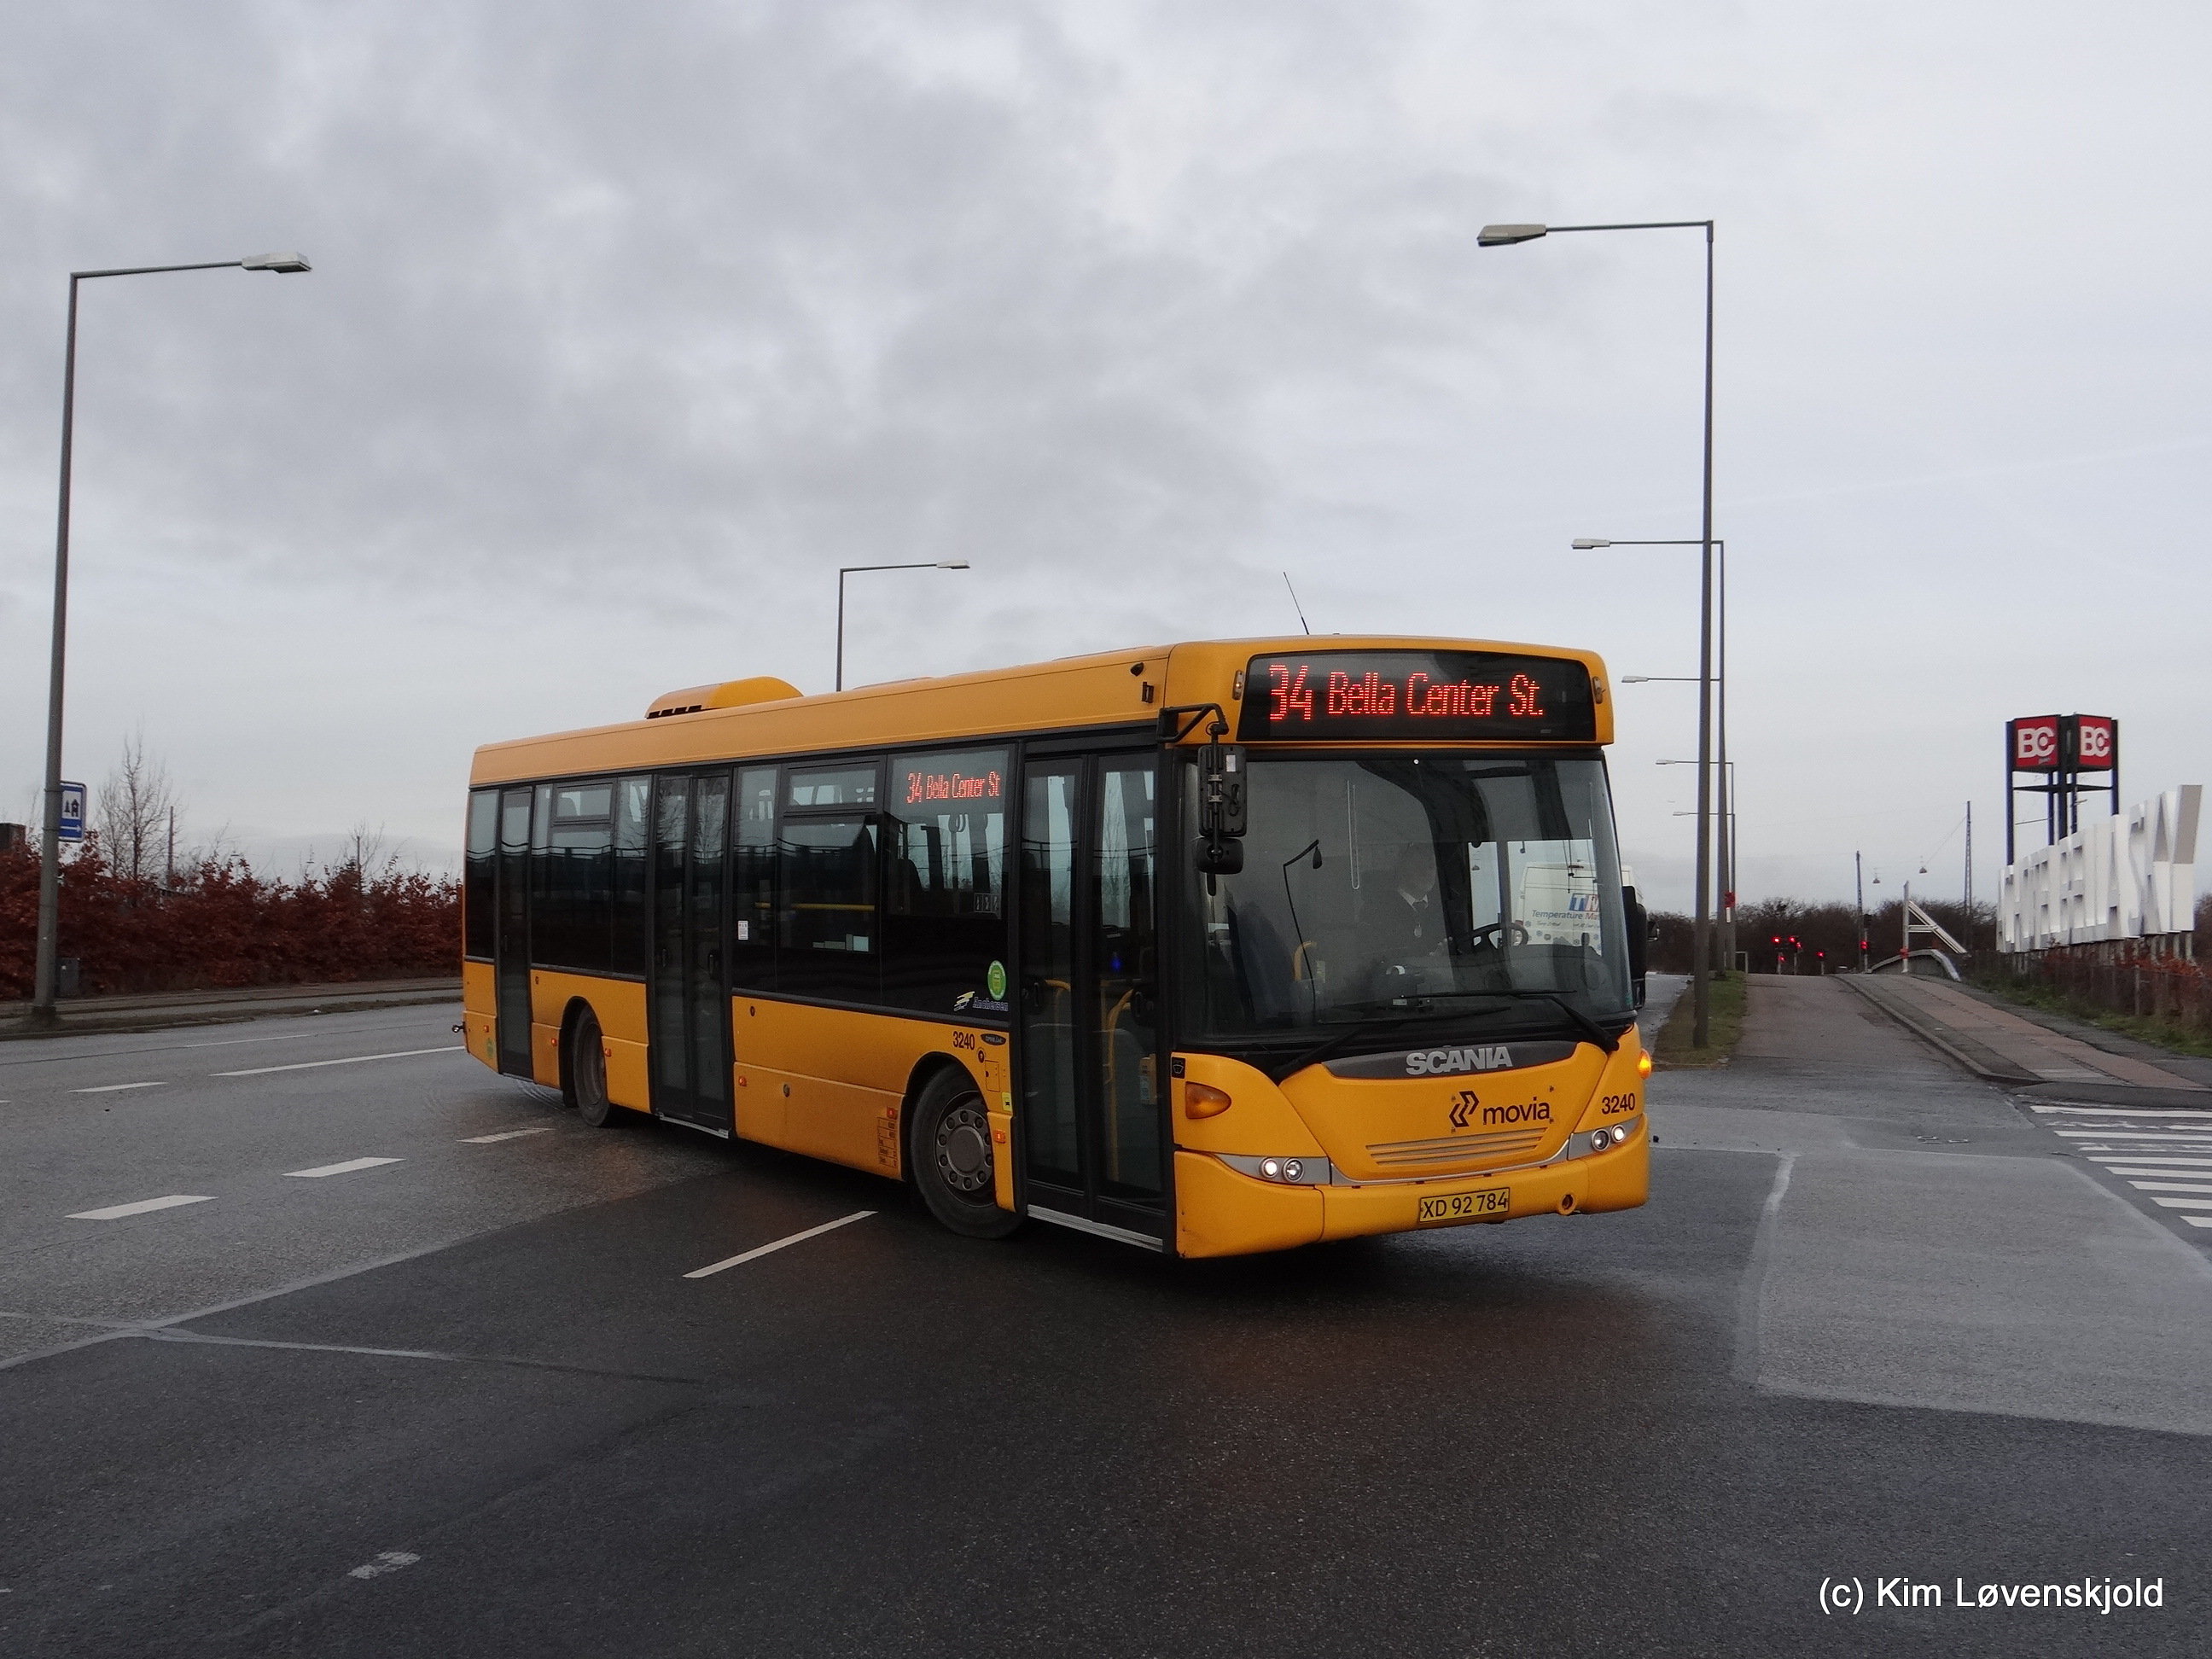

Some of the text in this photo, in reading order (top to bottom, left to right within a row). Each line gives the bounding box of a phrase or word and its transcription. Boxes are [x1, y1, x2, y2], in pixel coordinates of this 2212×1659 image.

[1268, 664, 1544, 720] 34 Bella Center St.
[2017, 726, 2056, 759] BC
[2080, 725, 2110, 757] BC
[906, 771, 923, 804] 34
[926, 774, 949, 800] Bella
[952, 773, 984, 798] Center
[1532, 910, 1583, 919] Temperature
[953, 1031, 975, 1050] 3240
[1406, 1046, 1513, 1075] SCANIA
[1483, 1096, 1550, 1126] movia
[1601, 1092, 1636, 1115] 3240
[1423, 1191, 1508, 1219] XD 92 784
